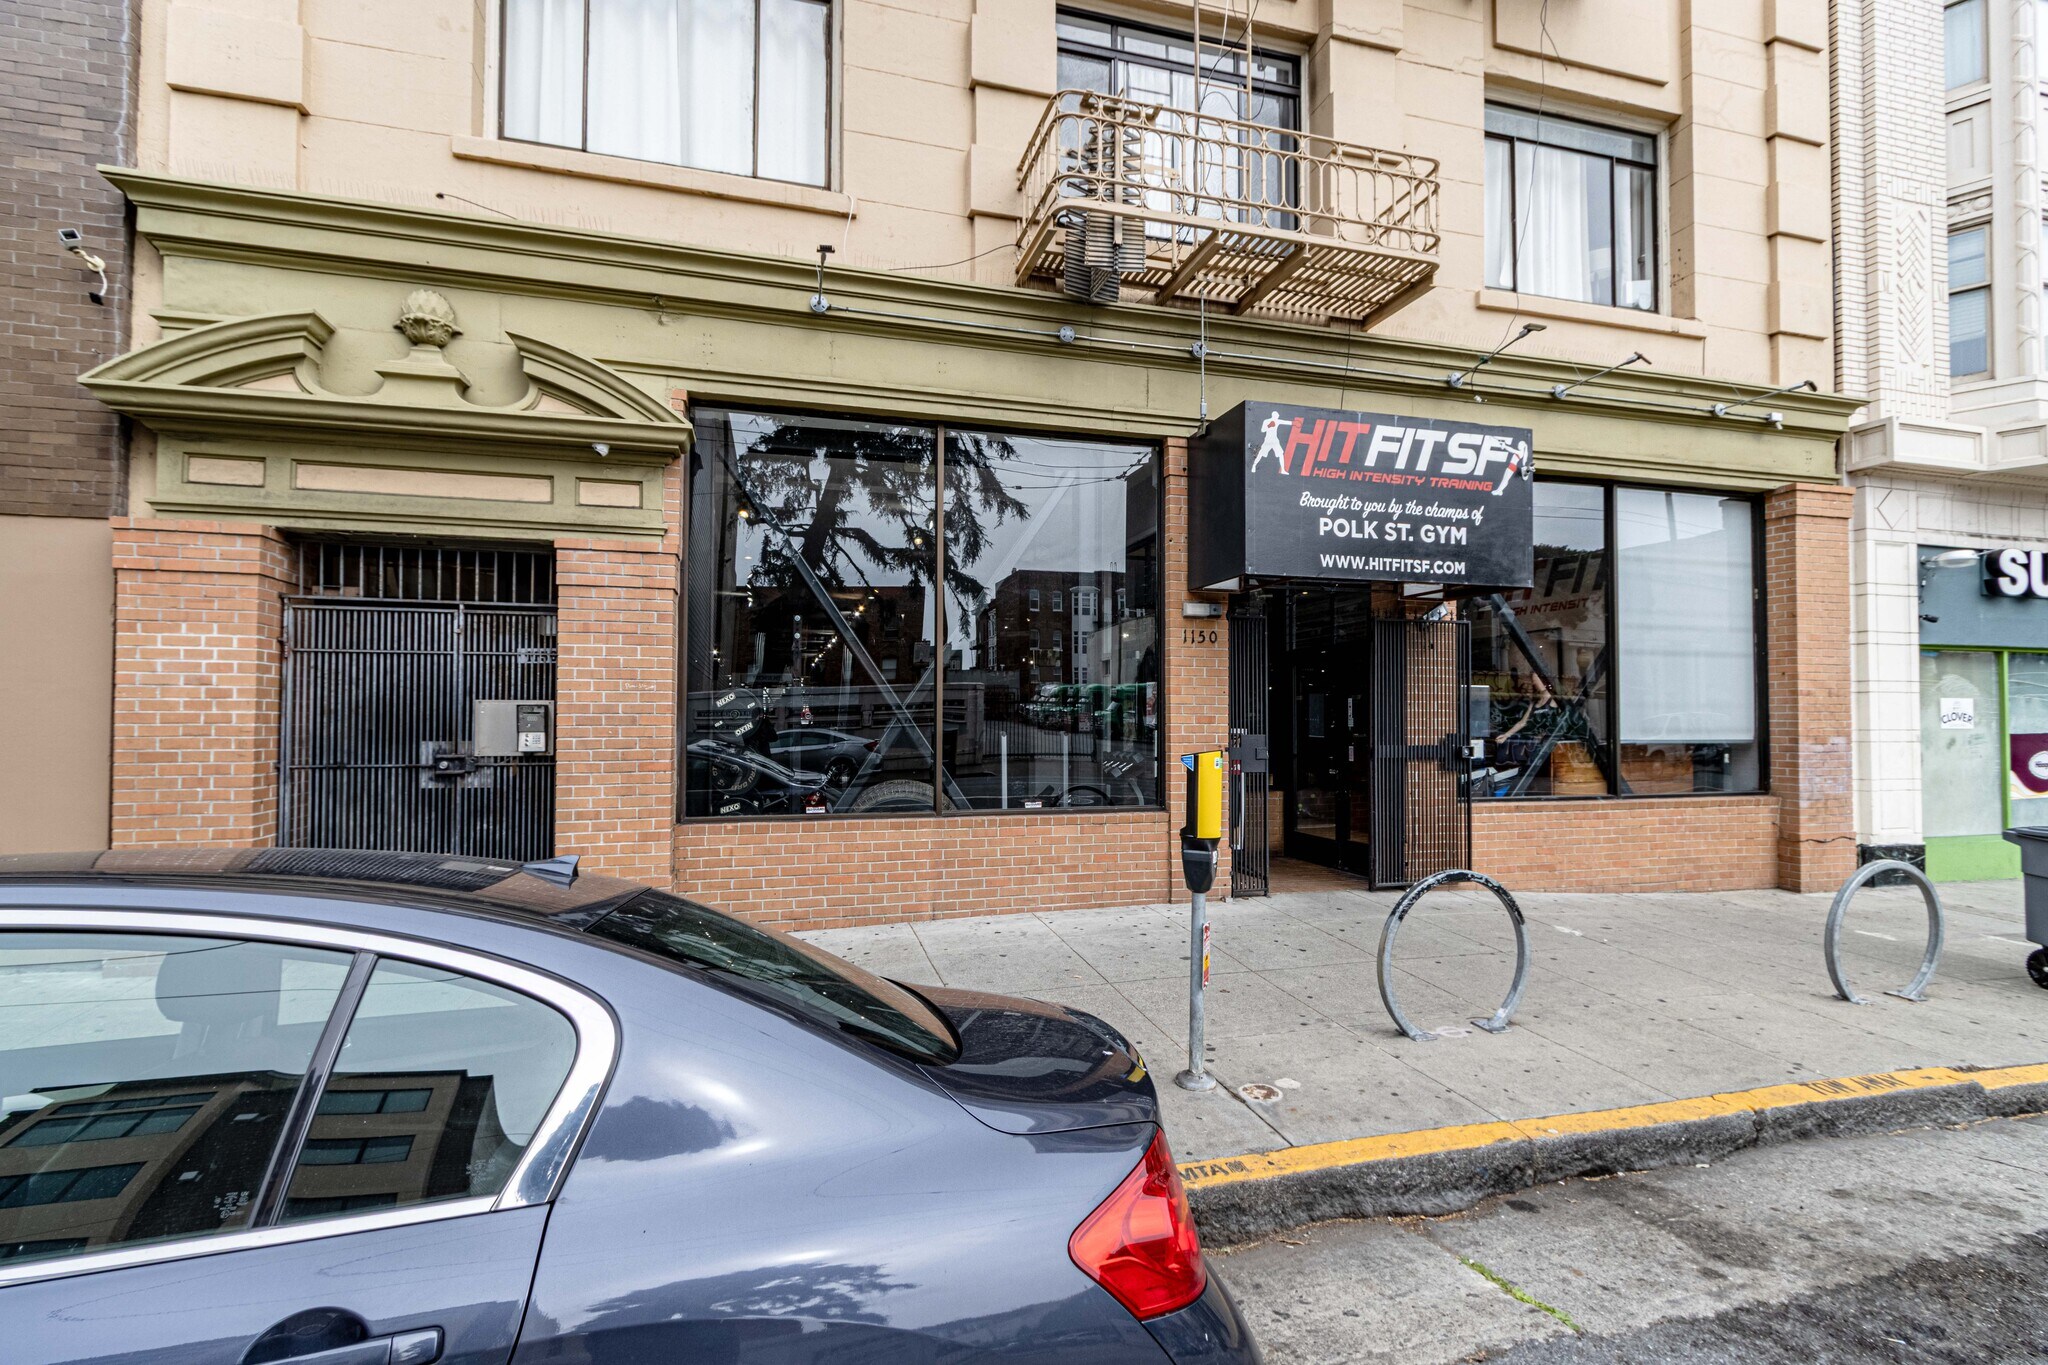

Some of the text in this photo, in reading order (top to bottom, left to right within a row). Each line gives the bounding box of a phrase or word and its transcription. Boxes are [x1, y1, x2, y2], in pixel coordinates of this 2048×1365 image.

[1279, 417, 1371, 476] HIT
[1313, 467, 1493, 492] HIGH INTENSITY TRAINING
[1299, 491, 1484, 526] Brought to you by the champs of
[1319, 517, 1467, 546] POLK ST. GYM
[1320, 553, 1466, 575] WWW.HITFITSF.COM
[1530, 596, 1601, 614] INTENSITY
[1182, 629, 1218, 645] 1150
[716, 692, 736, 707] NEXO
[1941, 711, 1974, 724] CLOVER
[720, 803, 741, 814] NEXO
